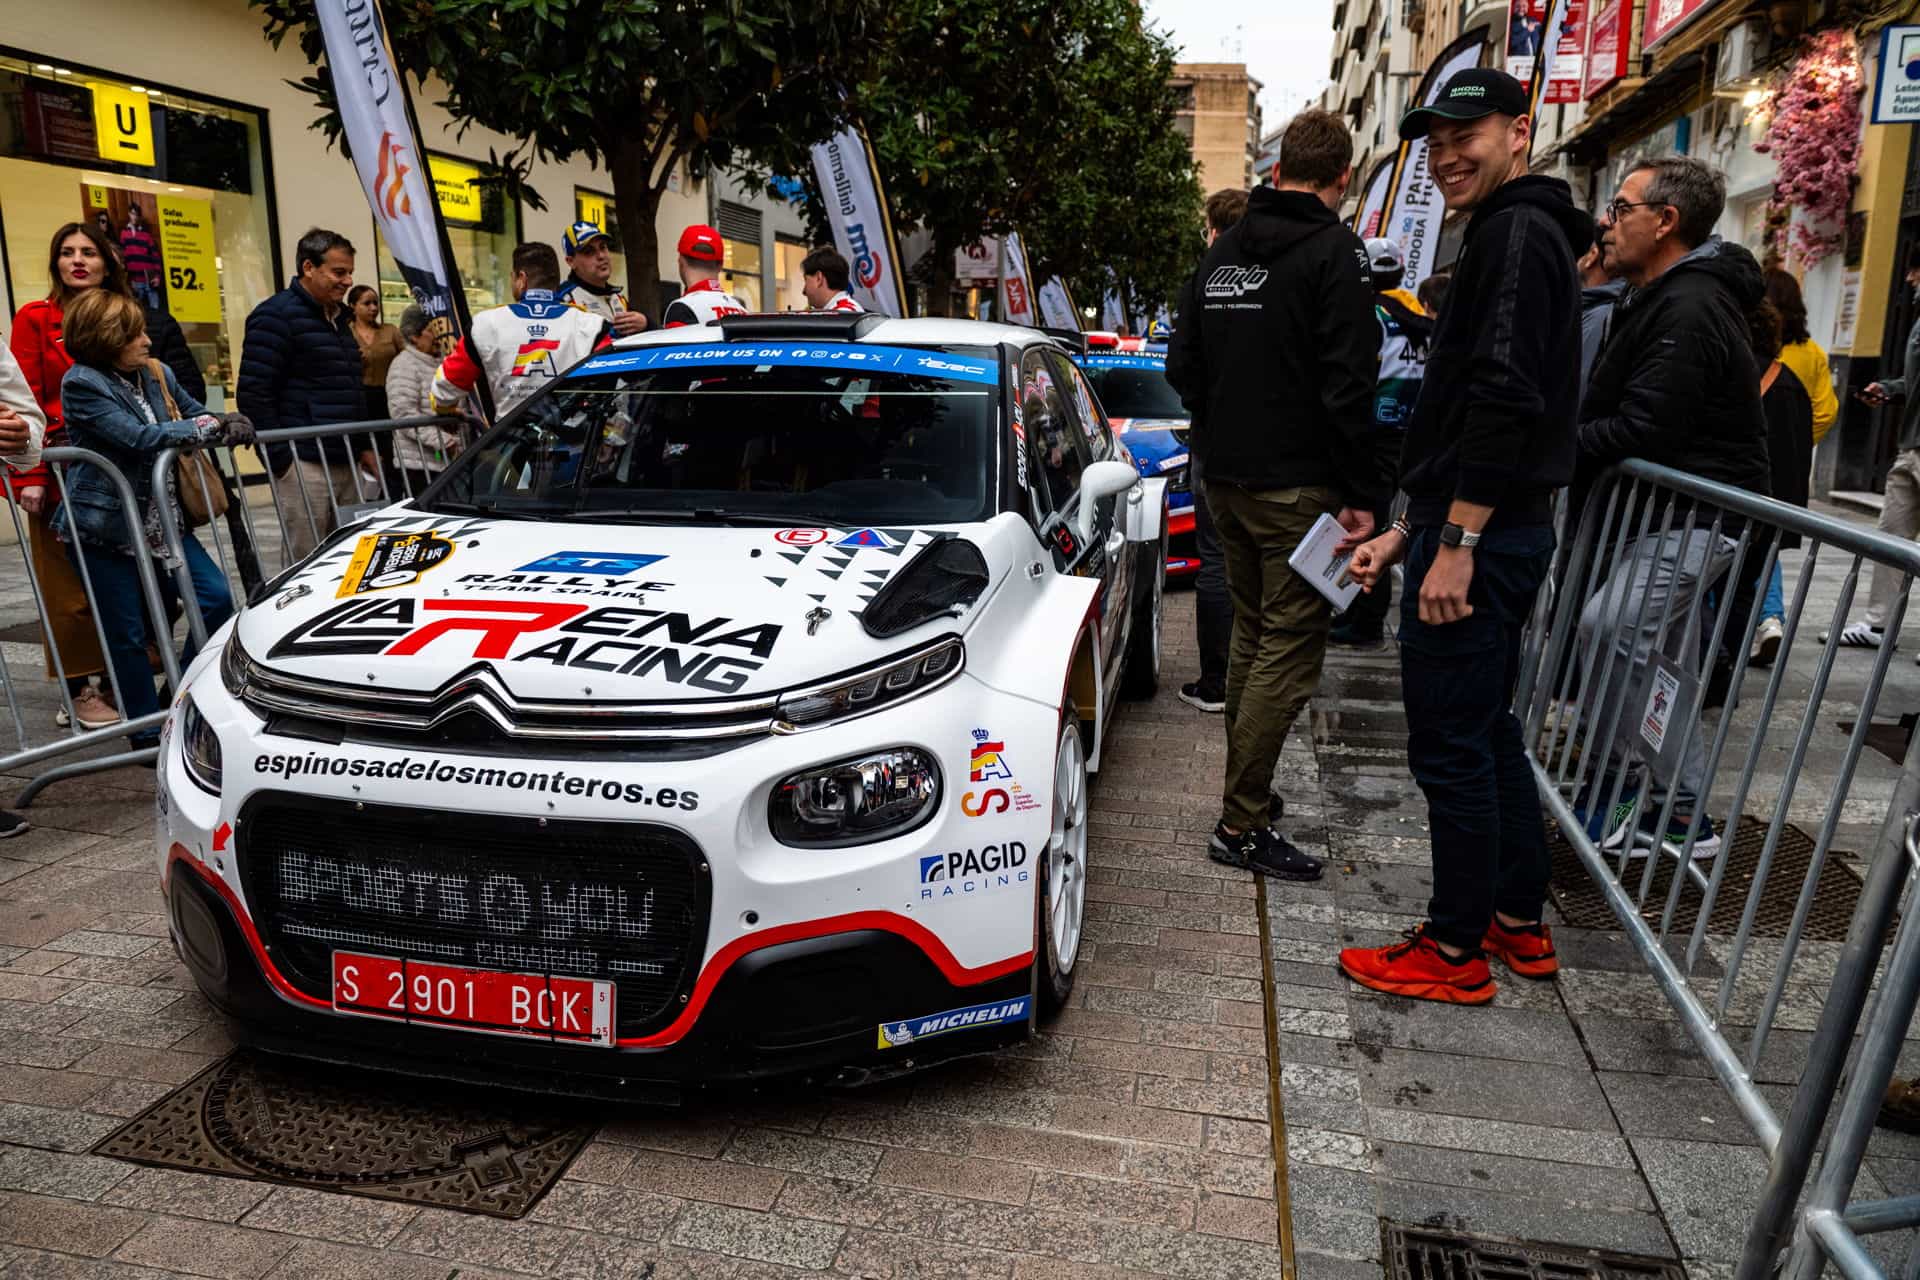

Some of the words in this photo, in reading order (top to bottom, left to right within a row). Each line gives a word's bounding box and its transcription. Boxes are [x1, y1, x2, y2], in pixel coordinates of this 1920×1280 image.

[115, 103, 137, 136] U
[664, 350, 730, 361] FOLLOW
[732, 349, 754, 357] US
[758, 349, 783, 358] ON
[455, 574, 677, 592] RALLYE
[463, 584, 544, 593] TEAM
[551, 588, 645, 599] SPAIN
[254, 750, 700, 812] espinosadelosmonteros.es
[948, 841, 1027, 879] PAGID
[921, 870, 1029, 900] RACING
[341, 965, 360, 1001] S
[387, 971, 475, 1019] 2901
[511, 984, 582, 1031] BCK
[918, 1002, 1025, 1036] MICHELIN
